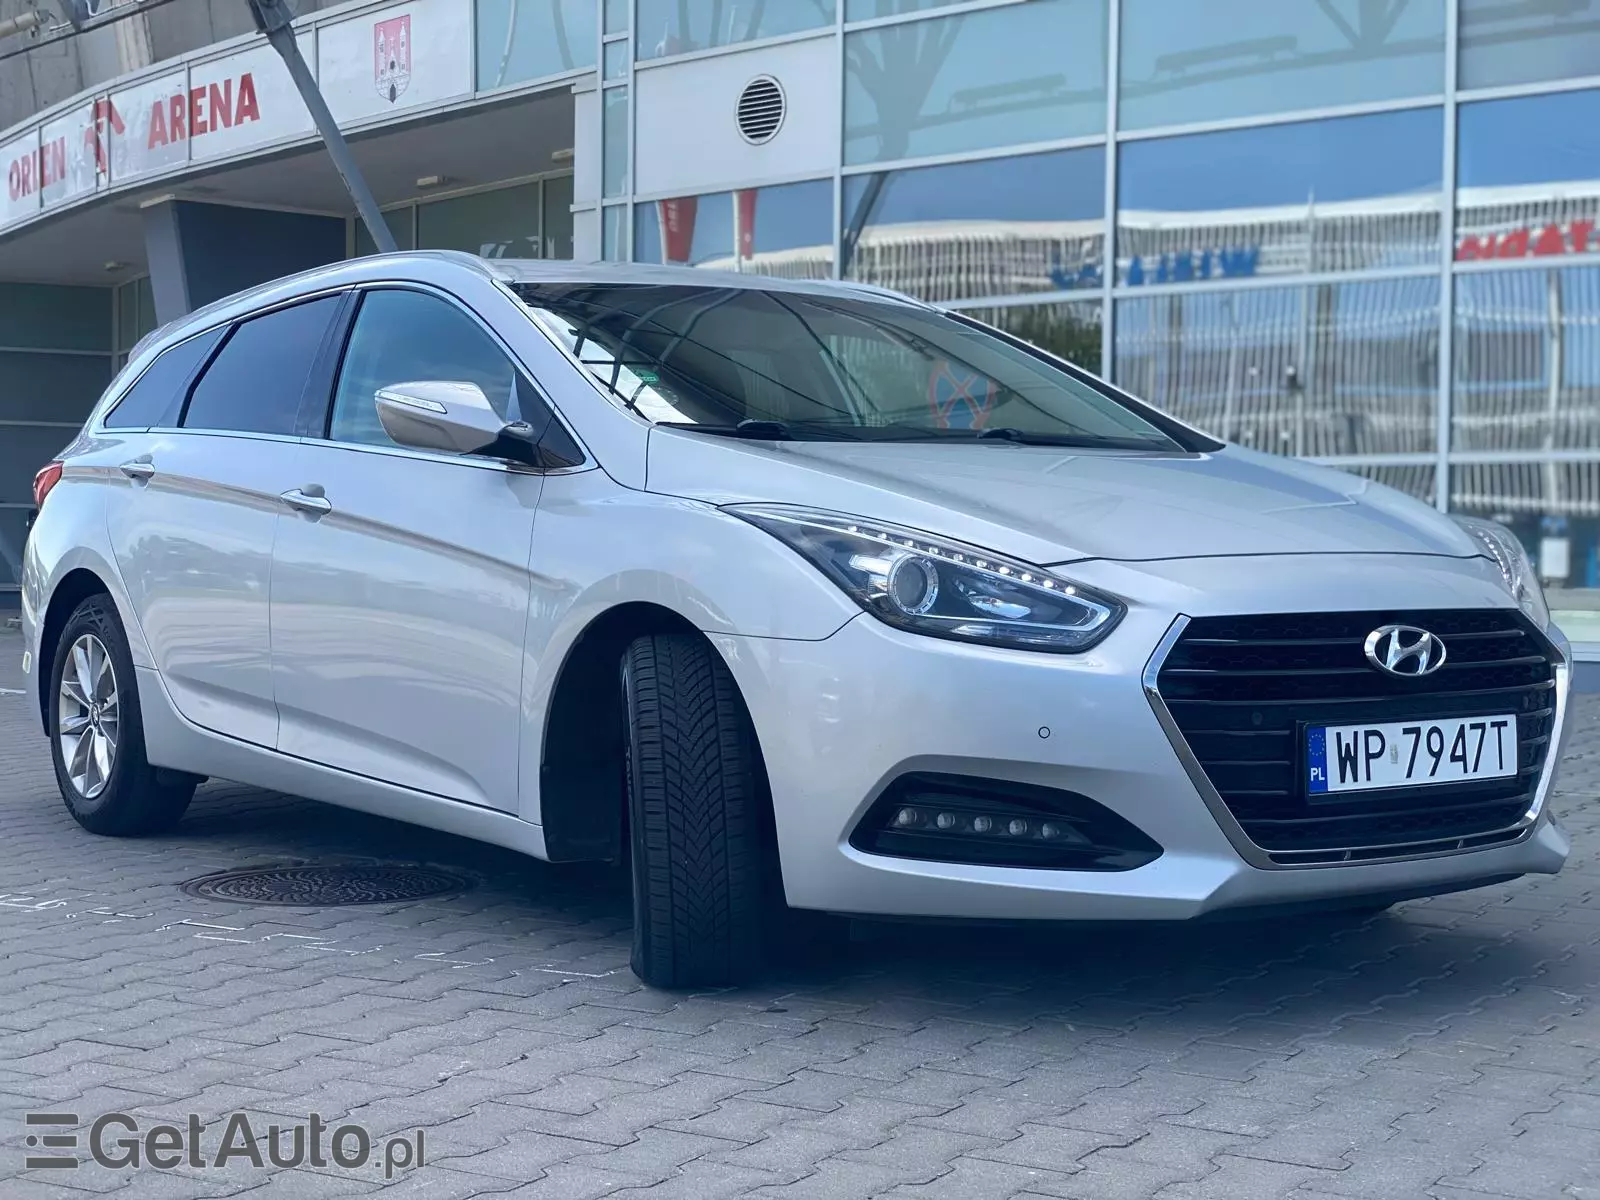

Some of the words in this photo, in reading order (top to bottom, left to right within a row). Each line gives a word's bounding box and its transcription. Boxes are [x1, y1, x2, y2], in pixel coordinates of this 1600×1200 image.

[148, 72, 260, 150] ARENA
[1310, 767, 1325, 782] PL
[1335, 730, 1386, 784] WP
[1402, 720, 1508, 779] 7947T
